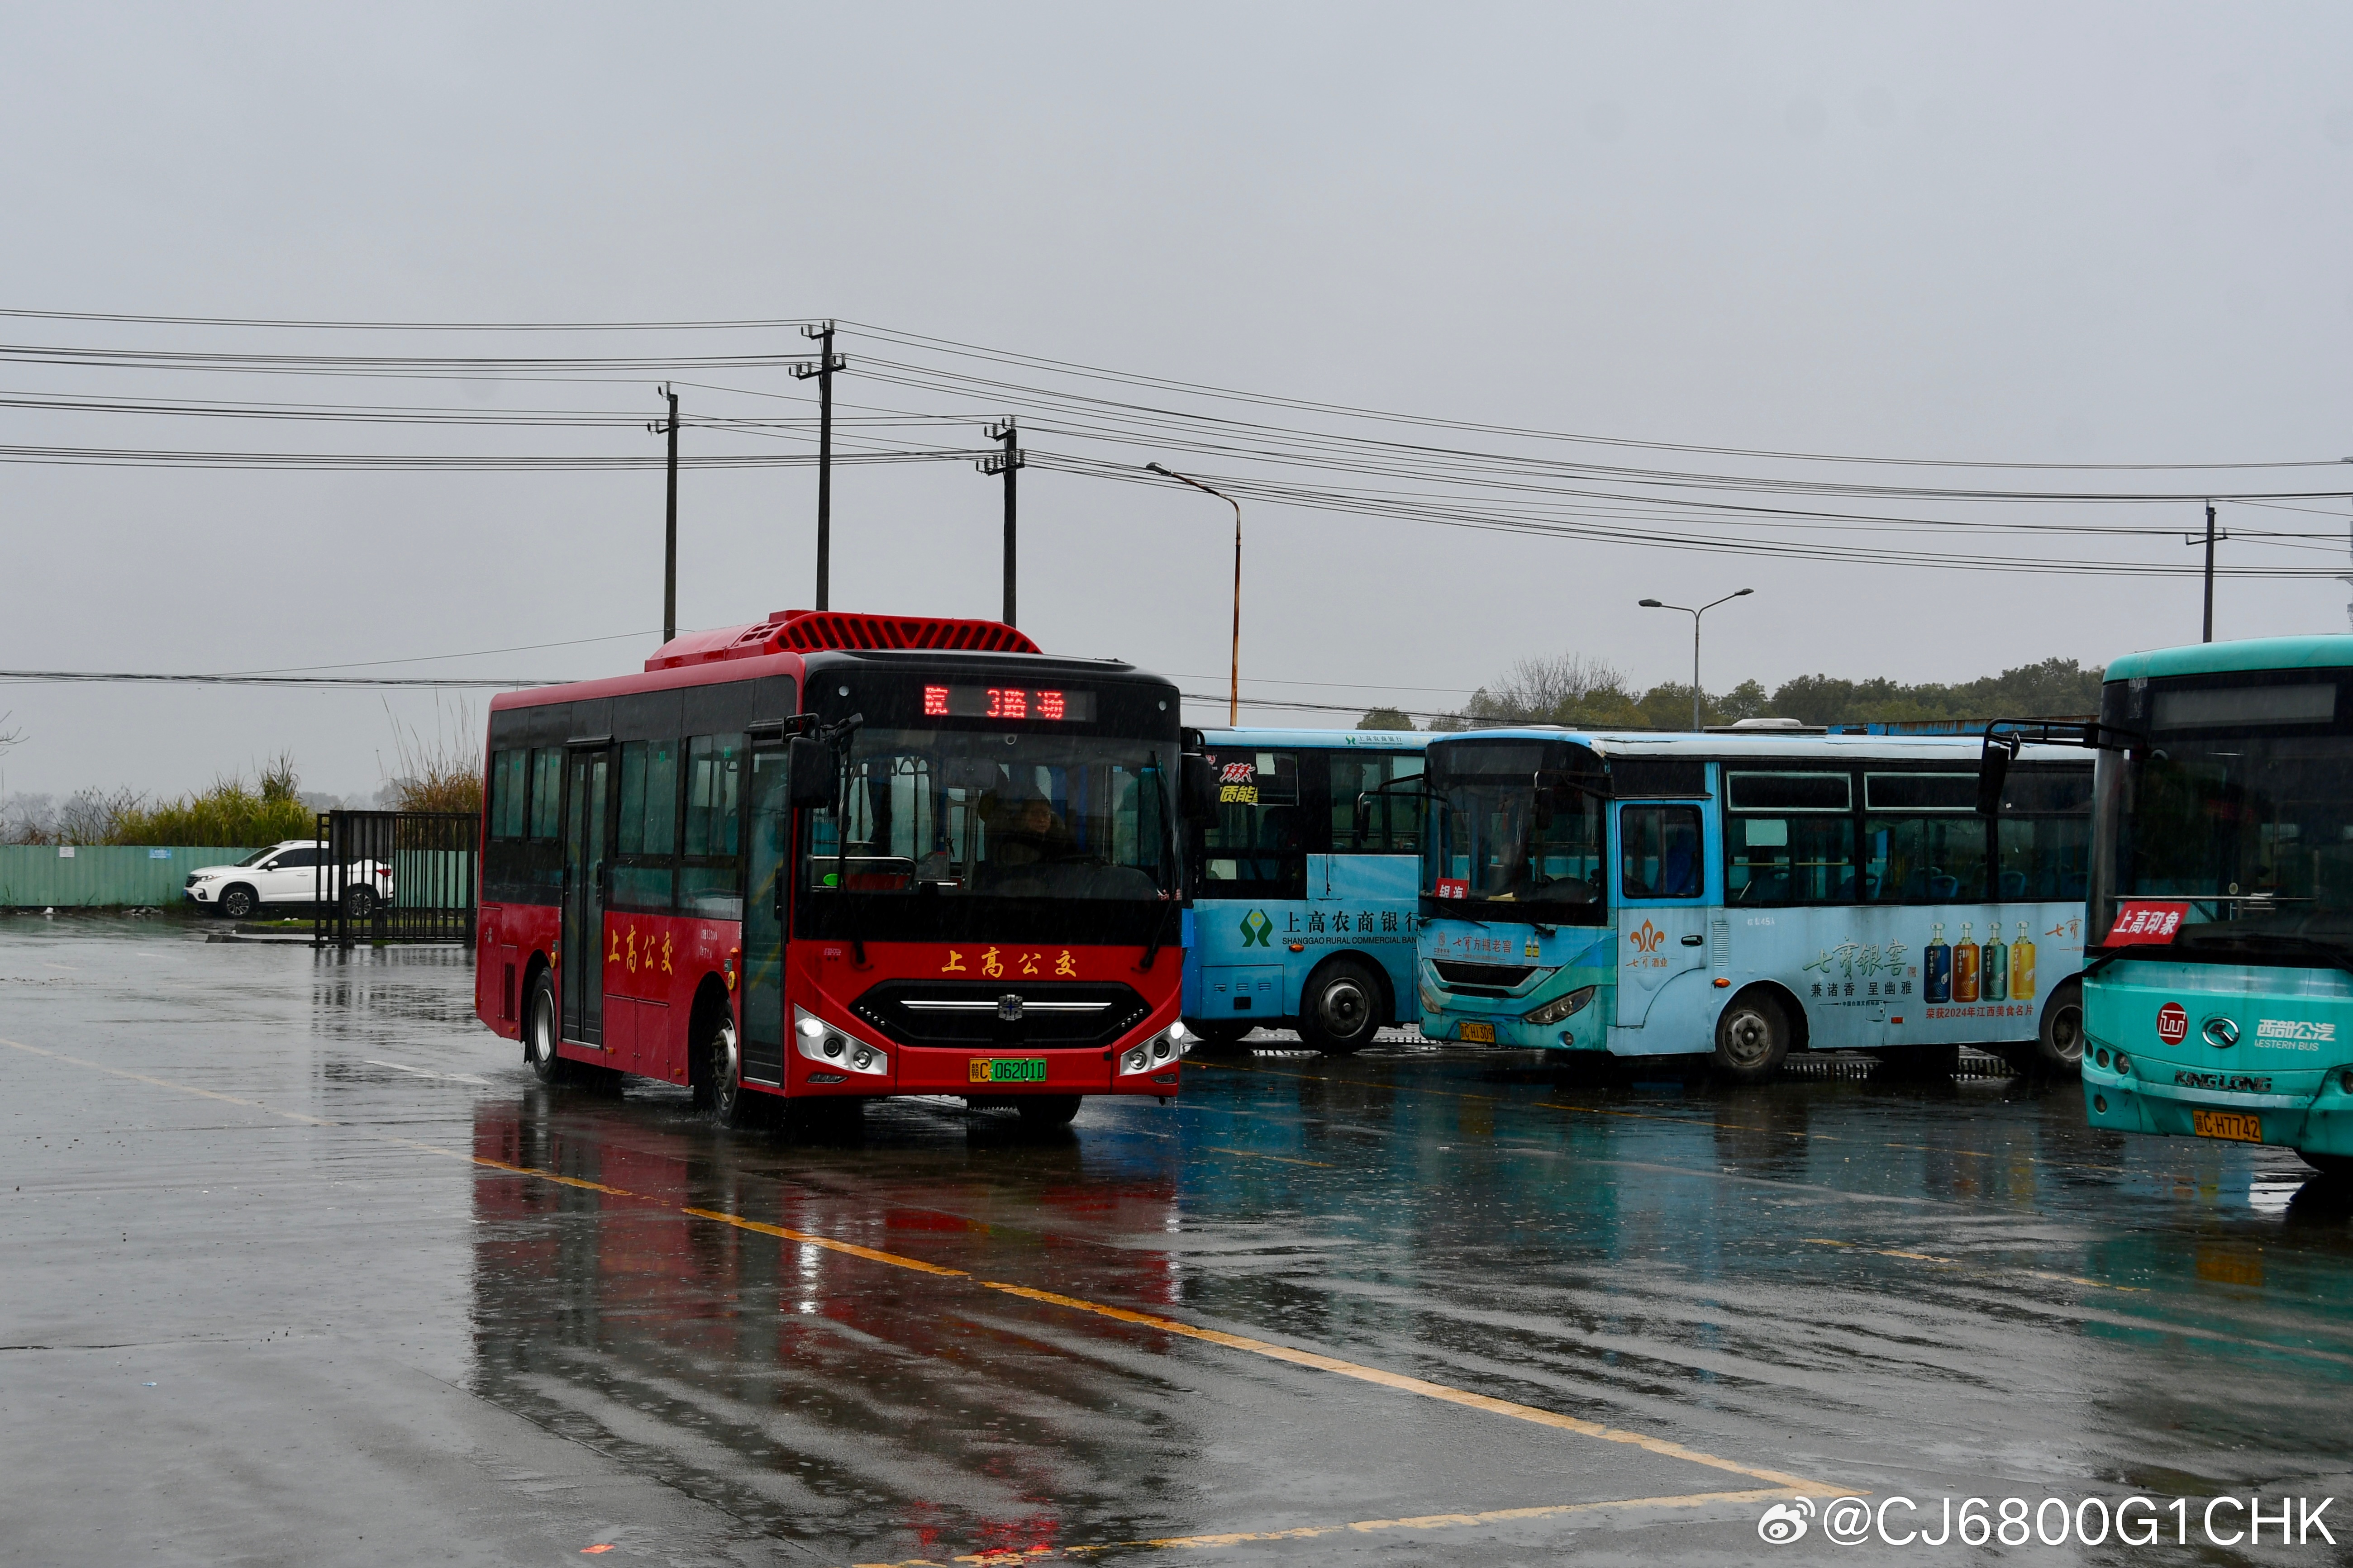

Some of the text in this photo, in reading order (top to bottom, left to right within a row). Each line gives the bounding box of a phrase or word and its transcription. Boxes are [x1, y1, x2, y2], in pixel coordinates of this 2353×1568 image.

[1220, 785, 1258, 802] 质能
[1283, 910, 1419, 934] 上高农商银行
[2113, 909, 2179, 935] 上高印象
[608, 924, 673, 975] 上高公交
[1282, 936, 1324, 945] SHANGGAO
[941, 946, 1076, 978] 上高公交
[1810, 980, 1913, 998] 兼诸香 呈幽雅
[1925, 1004, 2034, 1019] 荣获2024年江西美食名片
[2256, 1019, 2336, 1041] 西部公汽
[2298, 1041, 2320, 1051] BUS
